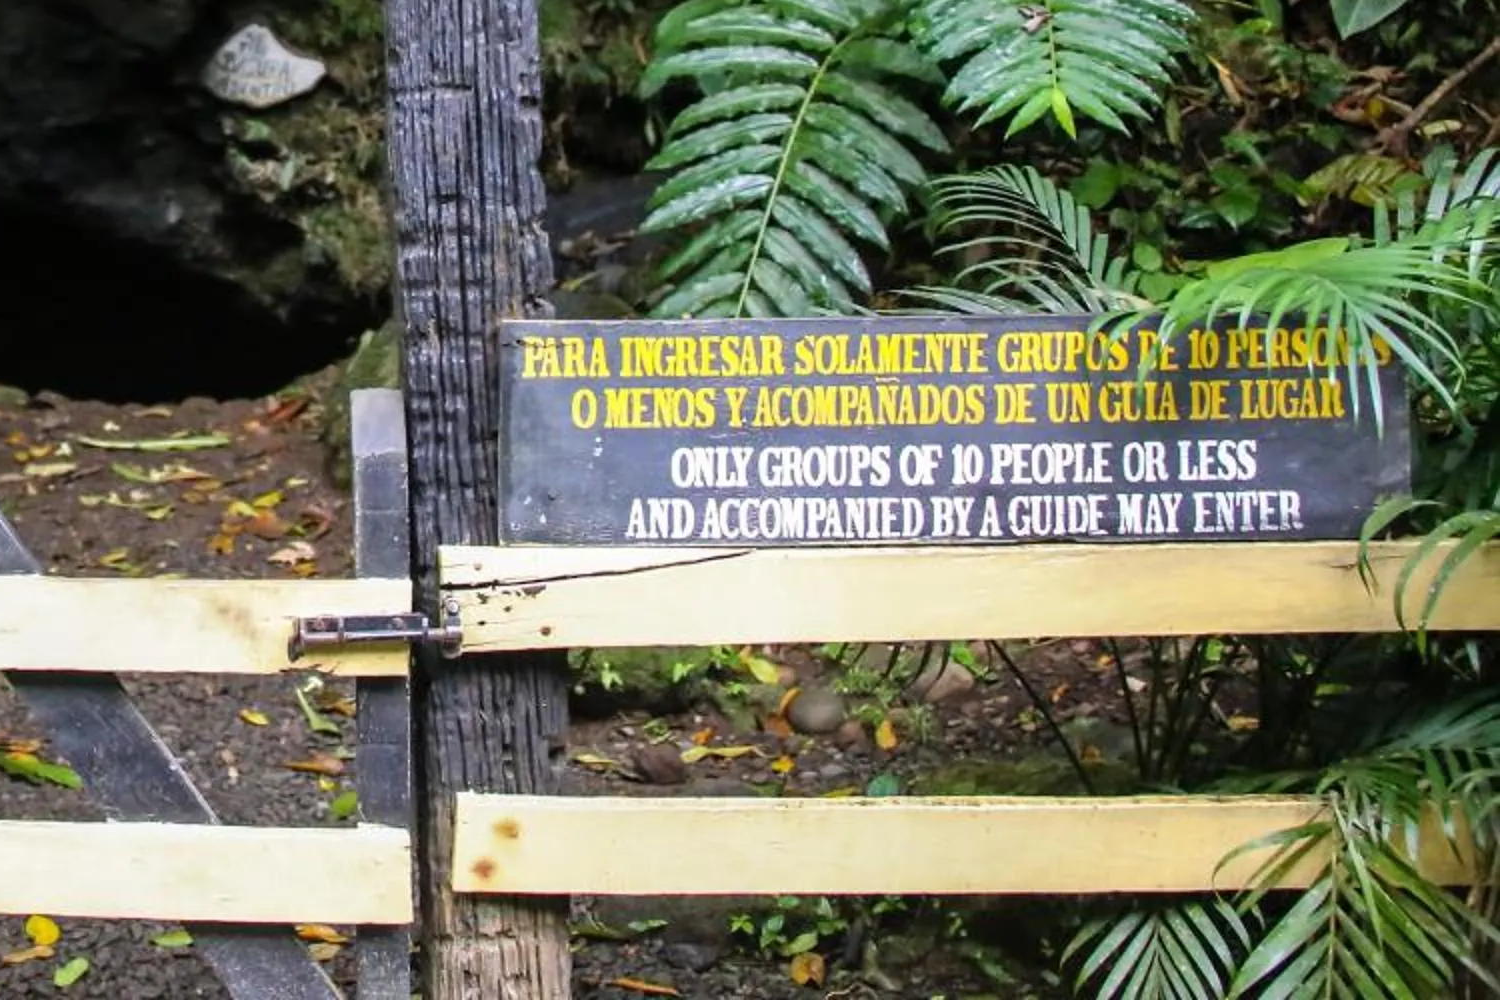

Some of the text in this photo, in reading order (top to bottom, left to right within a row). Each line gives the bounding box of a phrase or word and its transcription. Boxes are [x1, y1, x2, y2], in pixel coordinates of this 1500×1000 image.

[522, 328, 1390, 377] PARA INGRESAR SOLAMENTE GRUPOS DE 10 PERSONS
[571, 377, 1345, 429] O MENOS Y ACOMPAÑADOS DE UN GUIA DE LUGAR
[671, 440, 1257, 488] ONLY GROUPS OF 10 PEOPLE OR LESS
[625, 490, 1303, 540] AND ACCOMPANIED BY A GUIDE MAY ENTER
